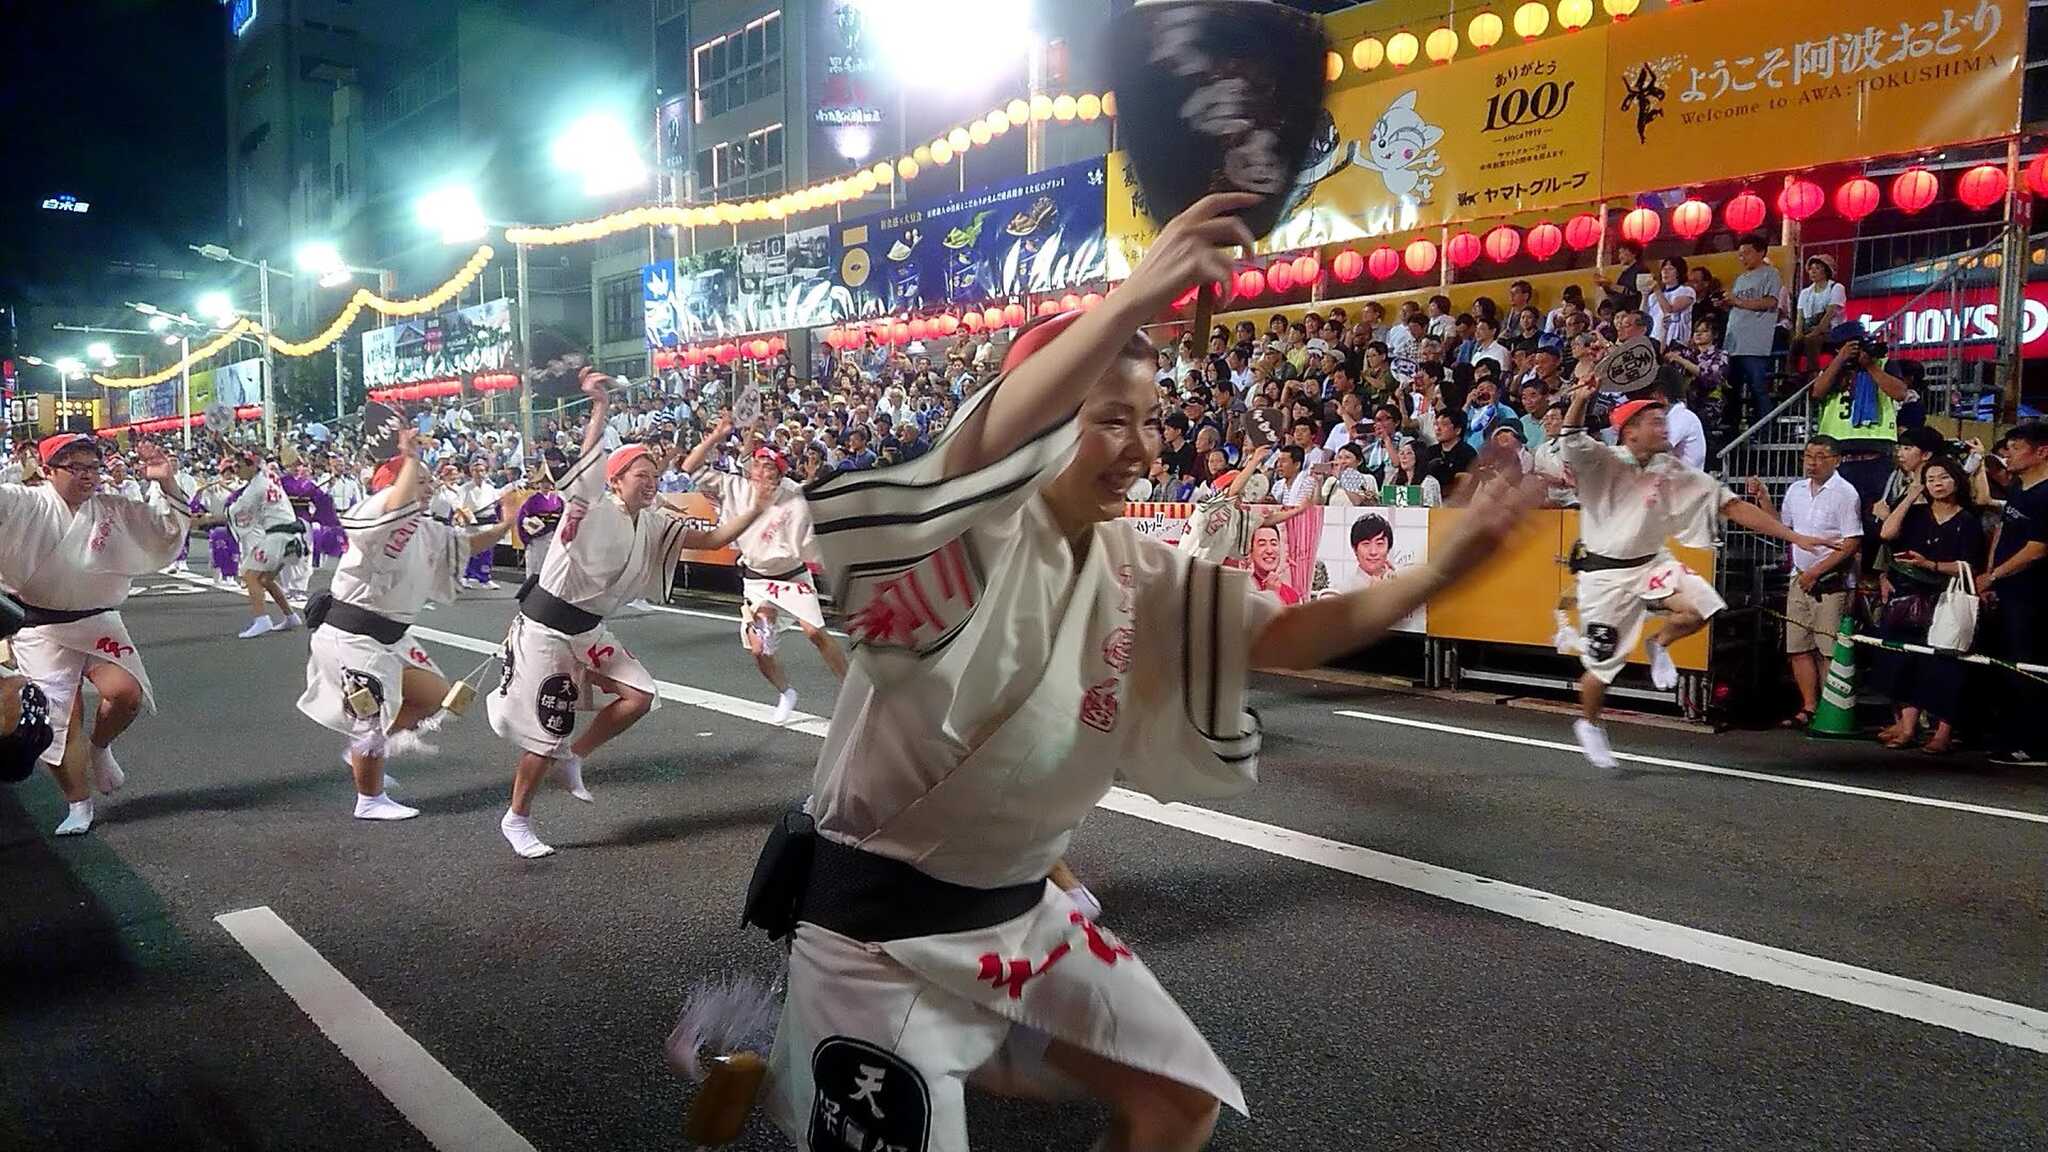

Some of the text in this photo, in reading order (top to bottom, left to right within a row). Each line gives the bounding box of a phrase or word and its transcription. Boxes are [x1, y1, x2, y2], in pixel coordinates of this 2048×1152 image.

[1680, 0, 2001, 104] ようこそ阿波おどり
[1494, 60, 1558, 88] ありがとう
[1681, 102, 1760, 125] Welcome
[1769, 96, 1788, 110] to
[1485, 171, 1591, 203] ヤマトグループ
[848, 1063, 887, 1119] 天
